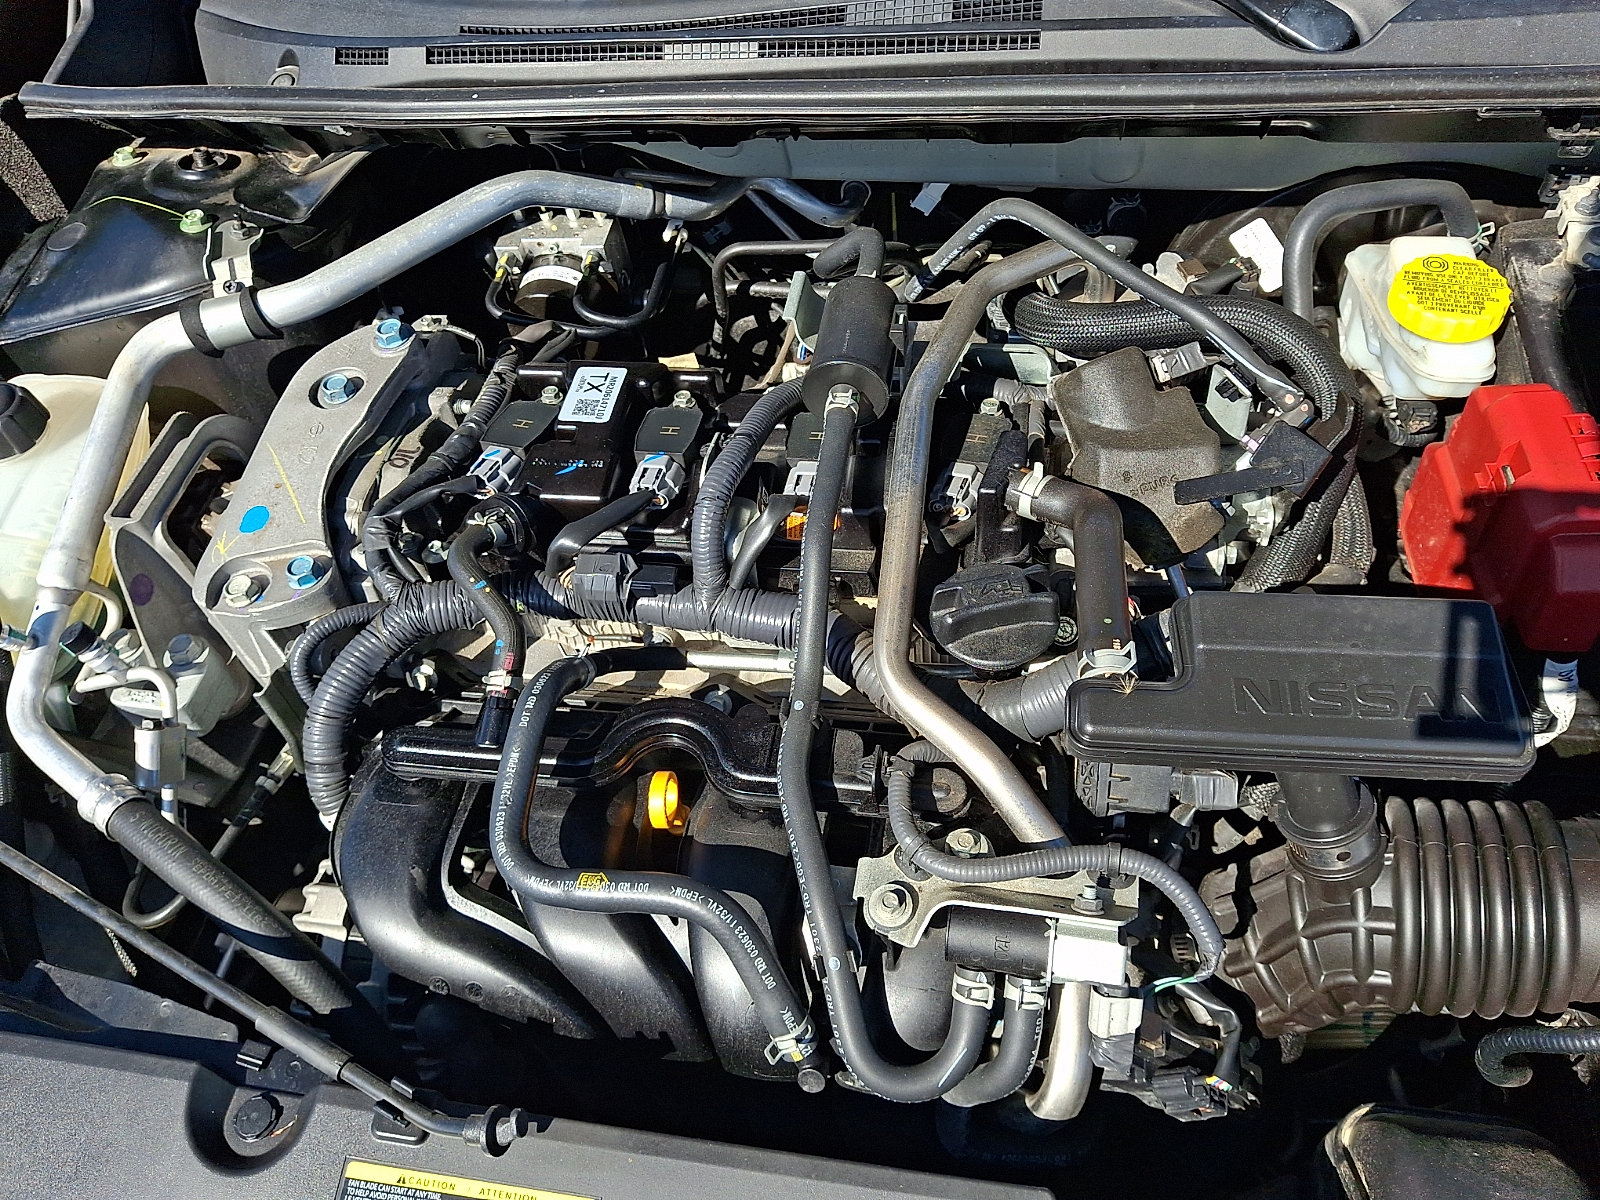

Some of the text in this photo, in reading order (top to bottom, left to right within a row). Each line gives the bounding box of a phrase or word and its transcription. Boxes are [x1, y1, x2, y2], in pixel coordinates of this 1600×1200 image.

[583, 372, 610, 394] TX
[659, 426, 681, 436] H
[389, 446, 421, 469] OIL
[1232, 677, 1503, 723] NISSAN
[519, 708, 531, 727] DOT
[494, 811, 506, 842] 030623
[501, 852, 515, 871] DOT
[633, 882, 650, 893] DOT
[734, 926, 761, 958] 030623
[760, 972, 777, 990] DOT
[347, 1186, 356, 1195] TO
[355, 1188, 370, 1197] HELP
[369, 1191, 388, 1200] AVOID
[348, 1179, 360, 1188] FAN
[360, 1180, 378, 1190] BLADE
[378, 1184, 391, 1192] CAN
[391, 1186, 408, 1196] START
[407, 1188, 416, 1196] AT
[408, 1176, 456, 1190] CAUTION
[479, 1188, 537, 1200] ATTENTION
